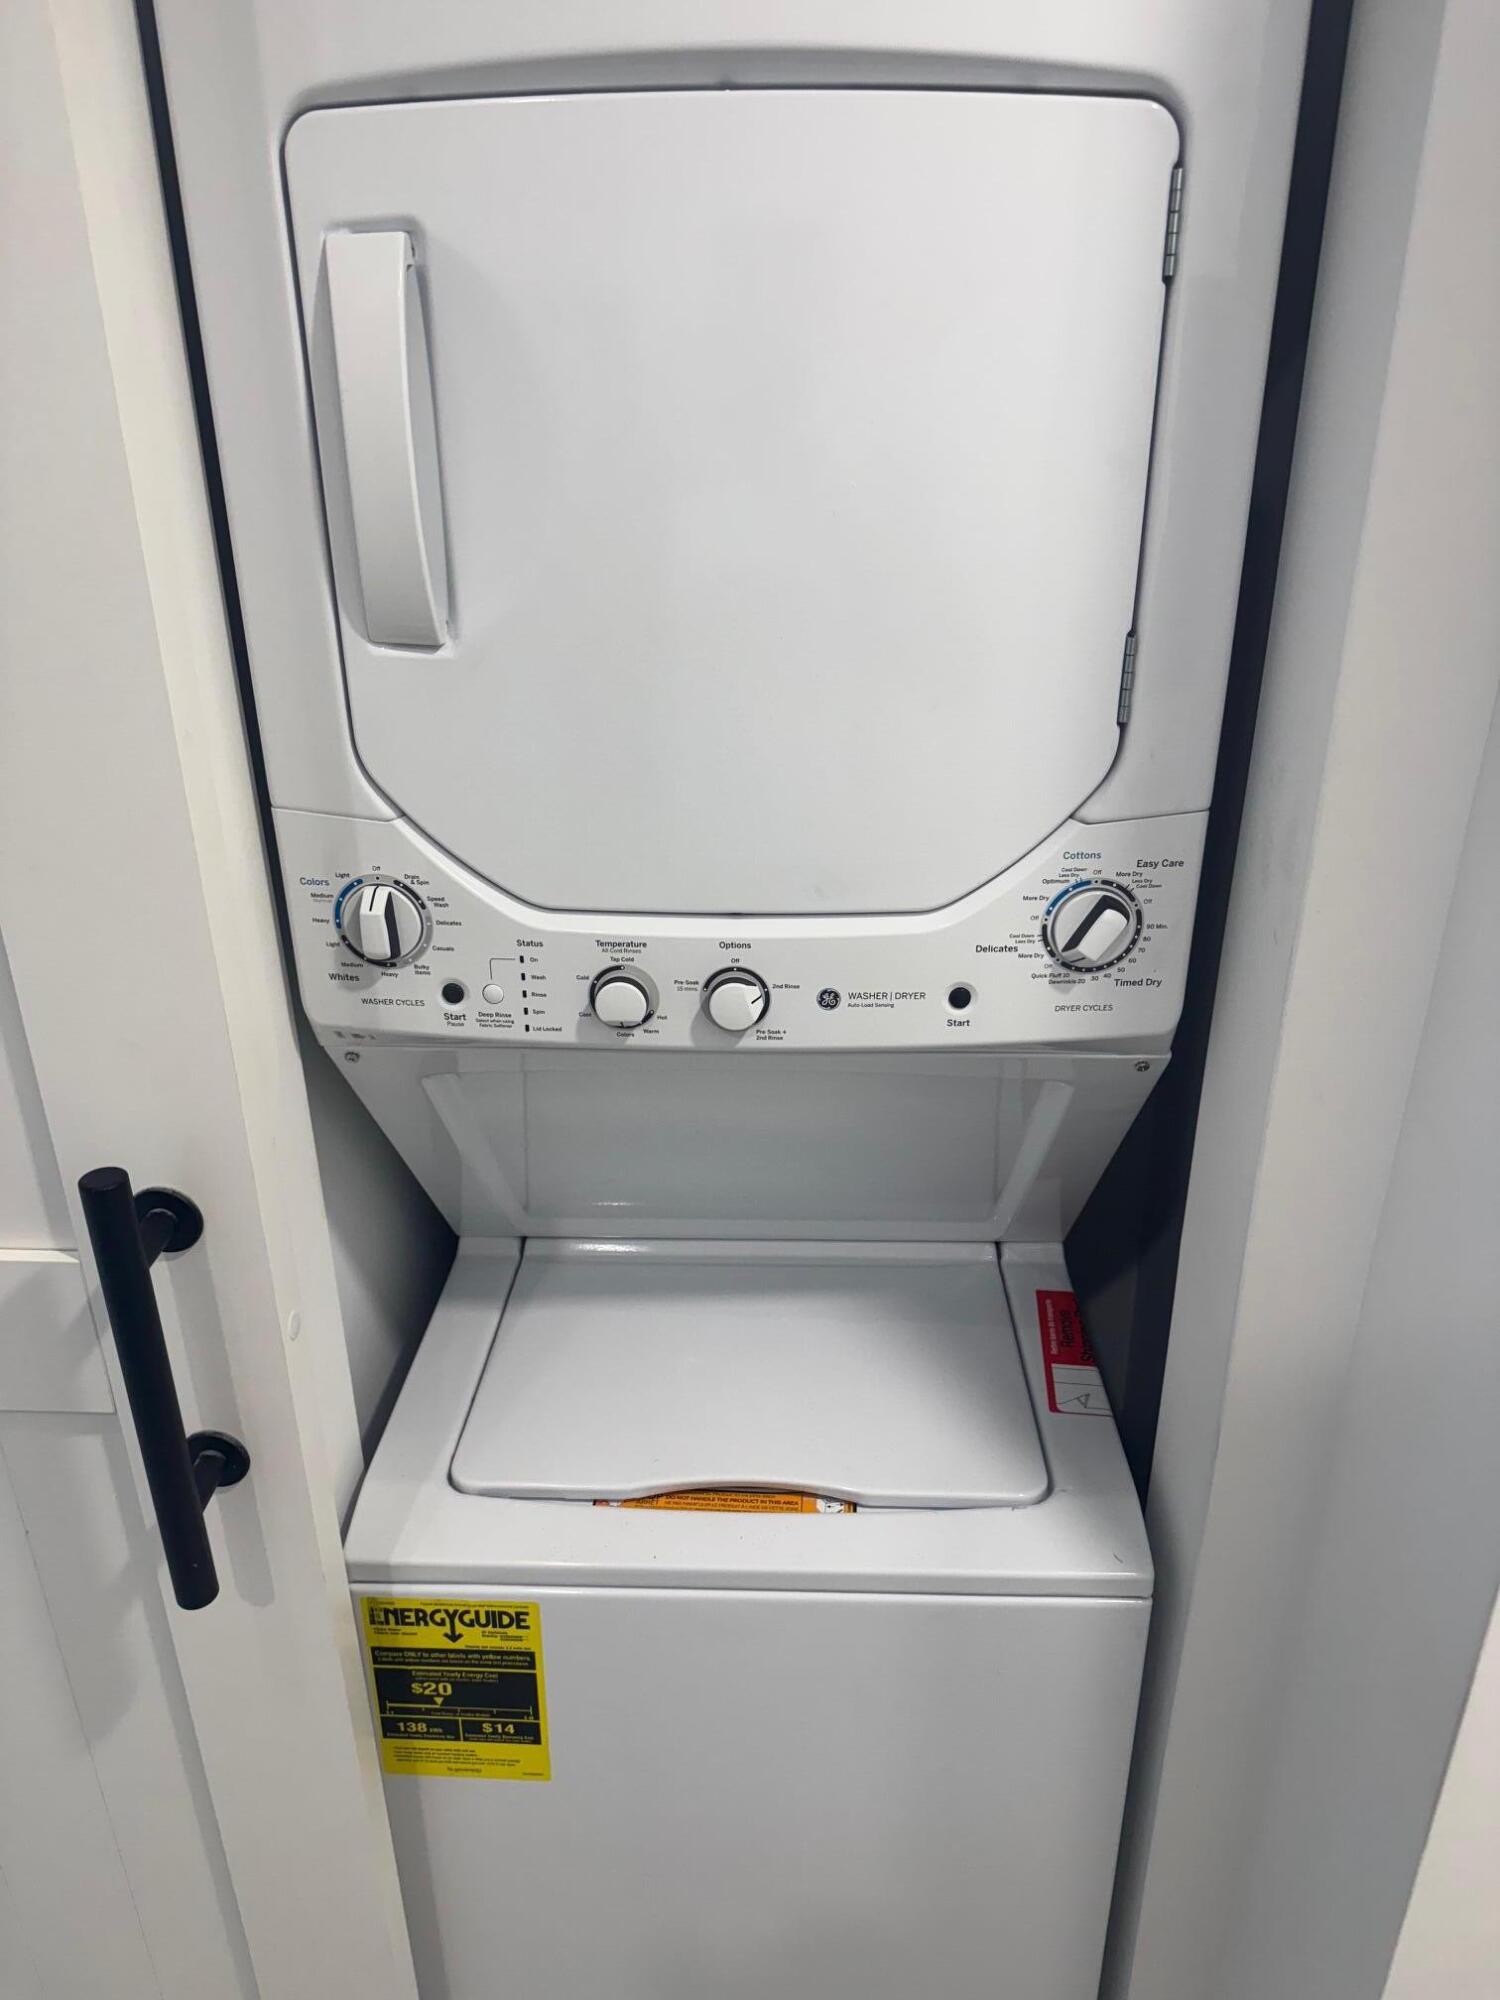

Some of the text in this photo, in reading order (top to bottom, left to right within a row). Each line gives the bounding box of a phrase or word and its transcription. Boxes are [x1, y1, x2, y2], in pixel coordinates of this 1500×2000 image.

[1063, 852, 1101, 860] Cottons
[1137, 859, 1184, 868] Easy Care
[300, 878, 330, 886] Colors
[517, 939, 543, 948] Status
[595, 940, 647, 948] Temperature
[719, 941, 751, 949] Options
[975, 945, 1018, 953] Delicates
[329, 973, 360, 982] Whites
[1115, 978, 1162, 987] Timed Dry
[848, 992, 889, 1000] WASHER
[894, 992, 926, 1000] DRYER
[444, 1013, 466, 1021] Start
[369, 1608, 530, 1630] ENERGYGUIDE
[411, 1683, 452, 1695] $20
[397, 1722, 427, 1732] 138
[482, 1723, 515, 1734] $14
